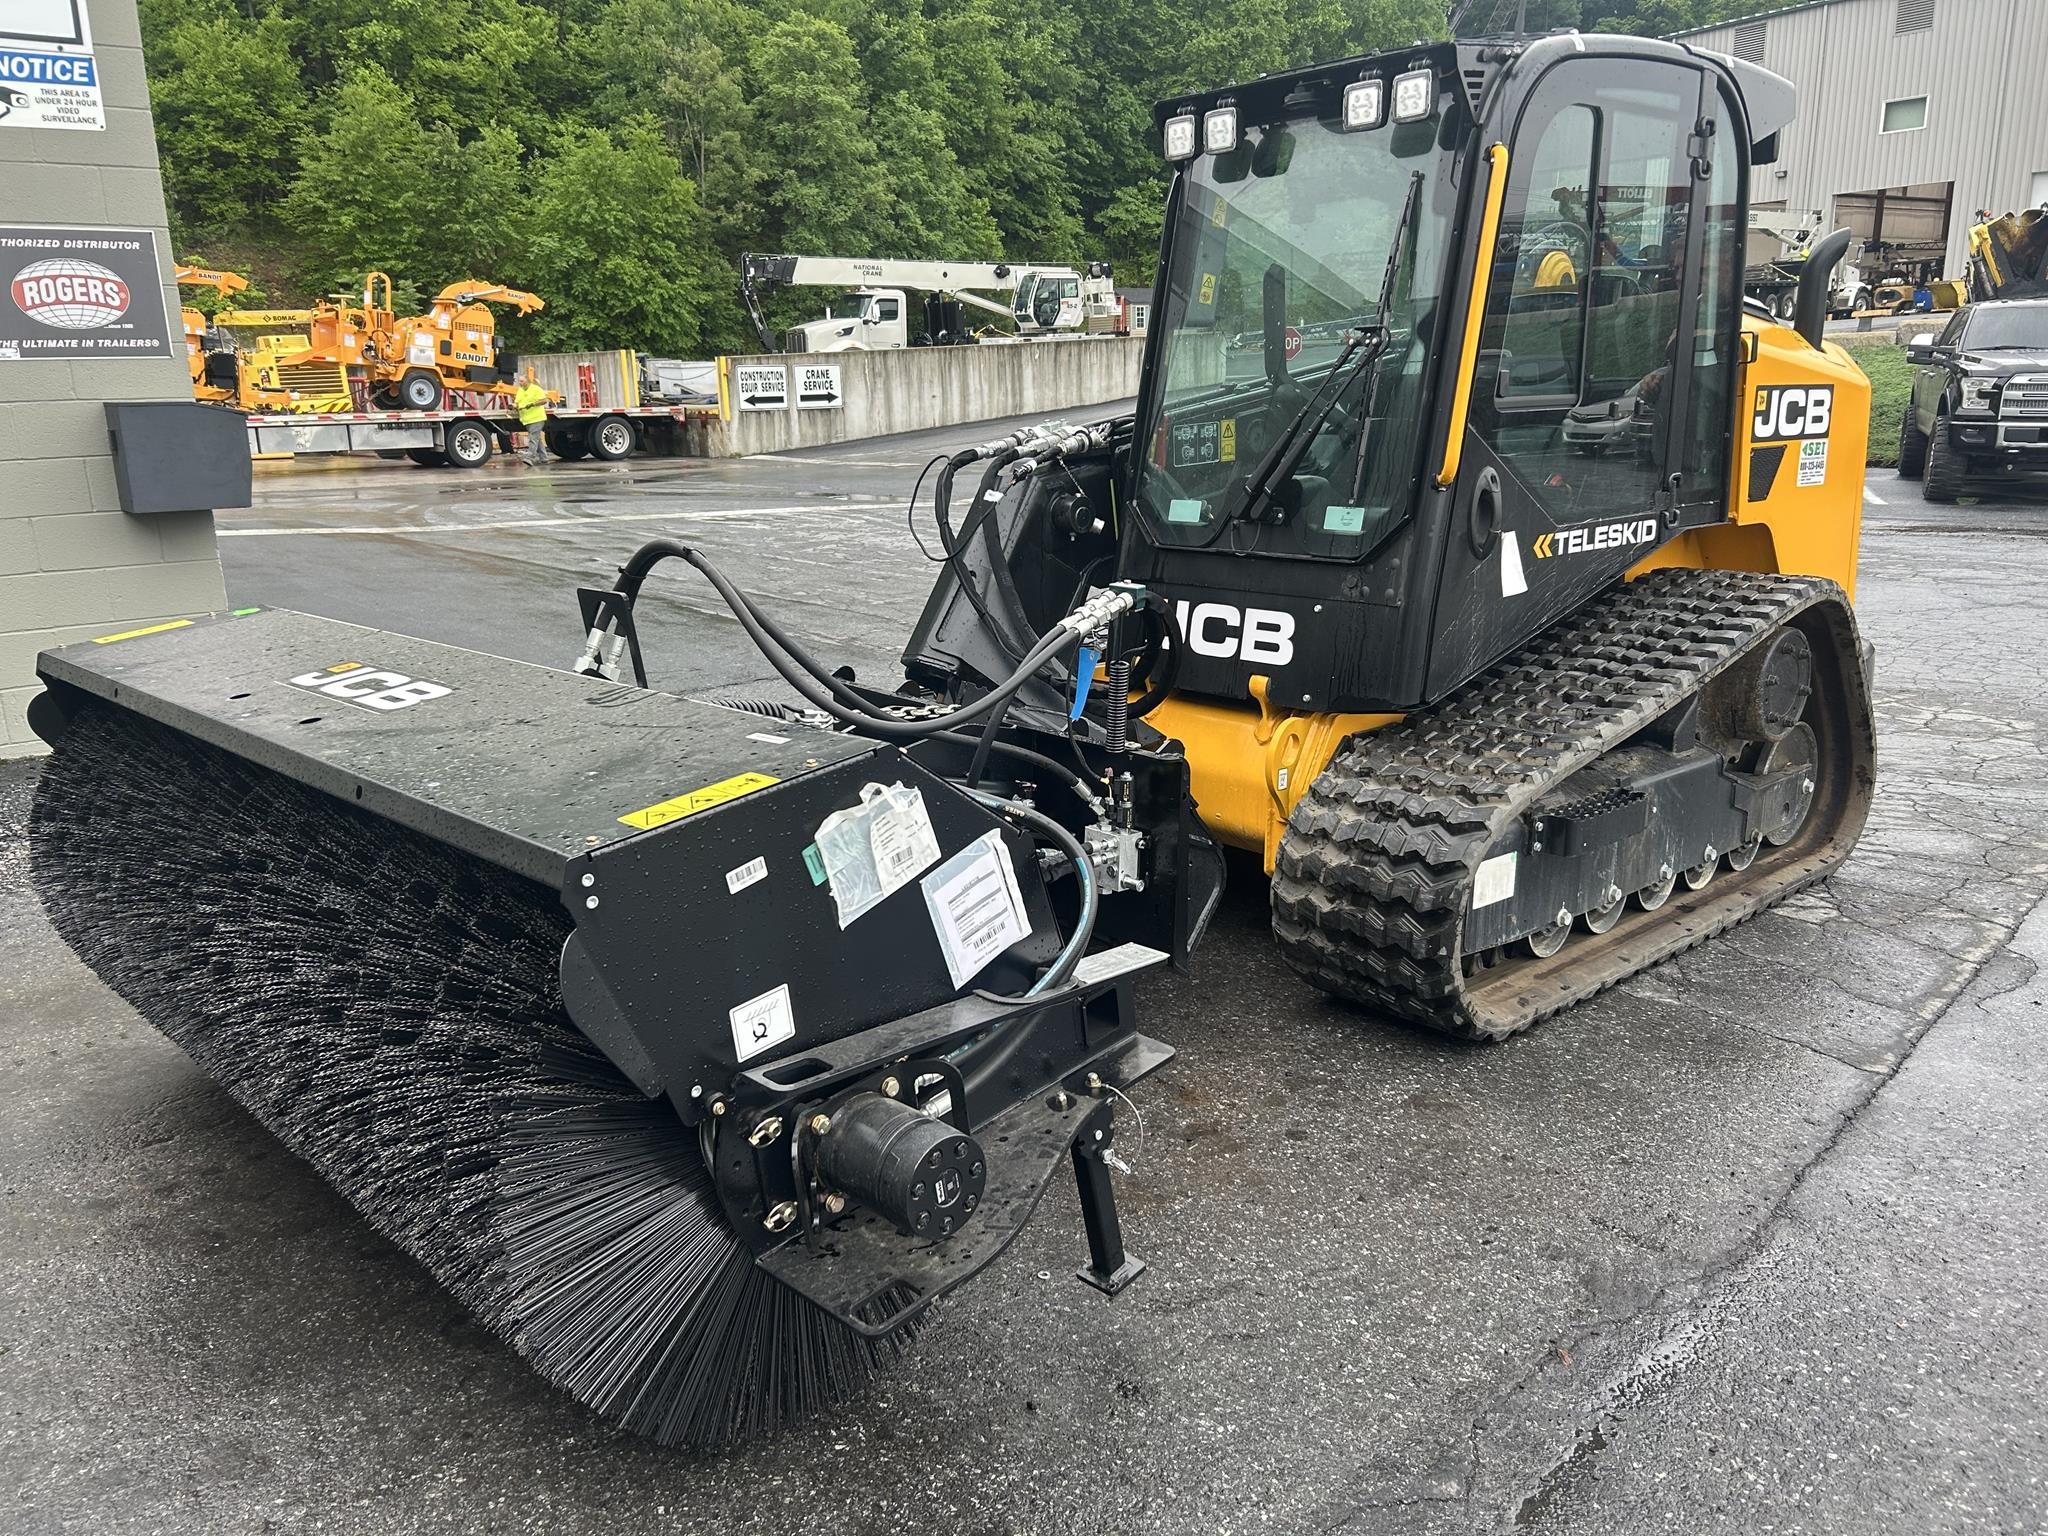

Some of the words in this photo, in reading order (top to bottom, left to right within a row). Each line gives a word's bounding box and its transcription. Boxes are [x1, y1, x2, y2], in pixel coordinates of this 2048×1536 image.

[0, 56, 89, 82] NOTICE
[40, 88, 58, 96] THIS
[60, 89, 80, 97] AREA
[82, 90, 90, 98] IS
[35, 97, 62, 105] UNDER
[64, 98, 74, 106] 24
[76, 99, 98, 107] HOUR
[57, 107, 80, 115] VIDEO
[41, 114, 97, 124] SURVEILLANCE
[0, 238, 61, 248] THORIZED
[64, 239, 140, 250] DISTRIBUTOR
[198, 273, 222, 281] BANDIT
[22, 277, 122, 307] ROGERS
[22, 339, 79, 348] ULTIMATE
[81, 339, 94, 348] IN
[1285, 337, 1300, 350] OP
[455, 351, 489, 363] BANDIT
[740, 371, 784, 381] CONSTRUCTION
[806, 369, 830, 380] CRANE
[761, 382, 785, 392] SERVICE
[803, 380, 834, 391] SERVICE
[1754, 389, 1832, 438] JCB
[1807, 441, 1826, 456] SEI
[1554, 519, 1657, 556] TELESKID
[290, 664, 453, 710] JCB
